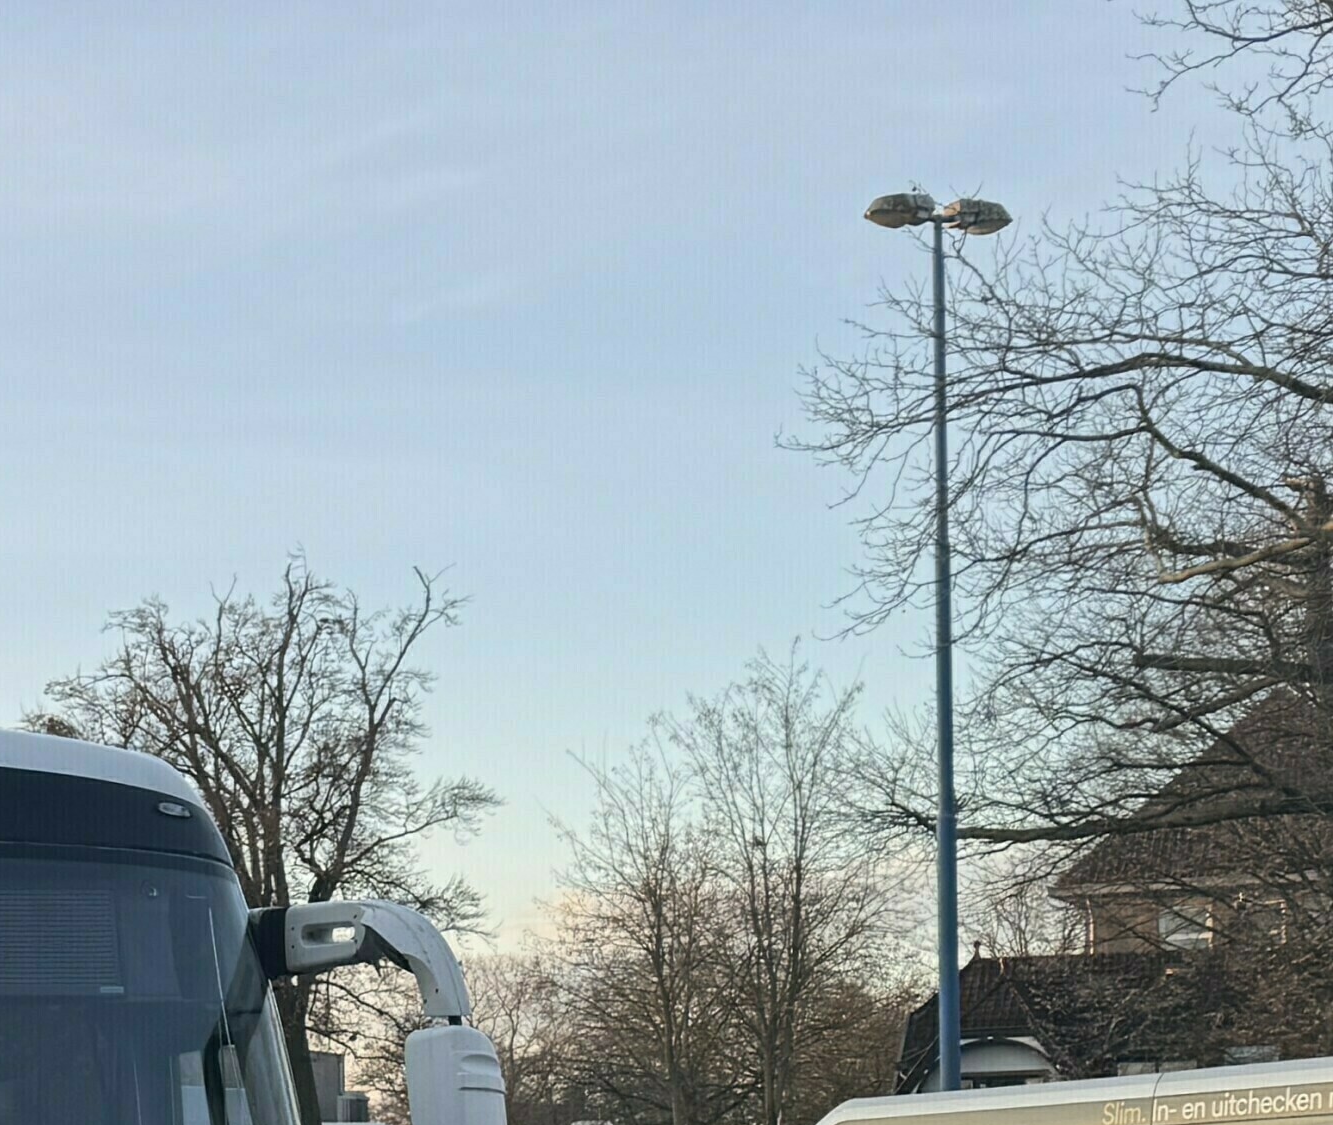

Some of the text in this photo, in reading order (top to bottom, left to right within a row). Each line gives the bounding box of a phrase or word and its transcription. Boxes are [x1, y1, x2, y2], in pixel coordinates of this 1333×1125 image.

[1102, 1102, 1146, 1125] Slim.
[1153, 1099, 1177, 1122] In-
[1182, 1099, 1206, 1120] en
[1211, 1087, 1323, 1118] uitchecken
